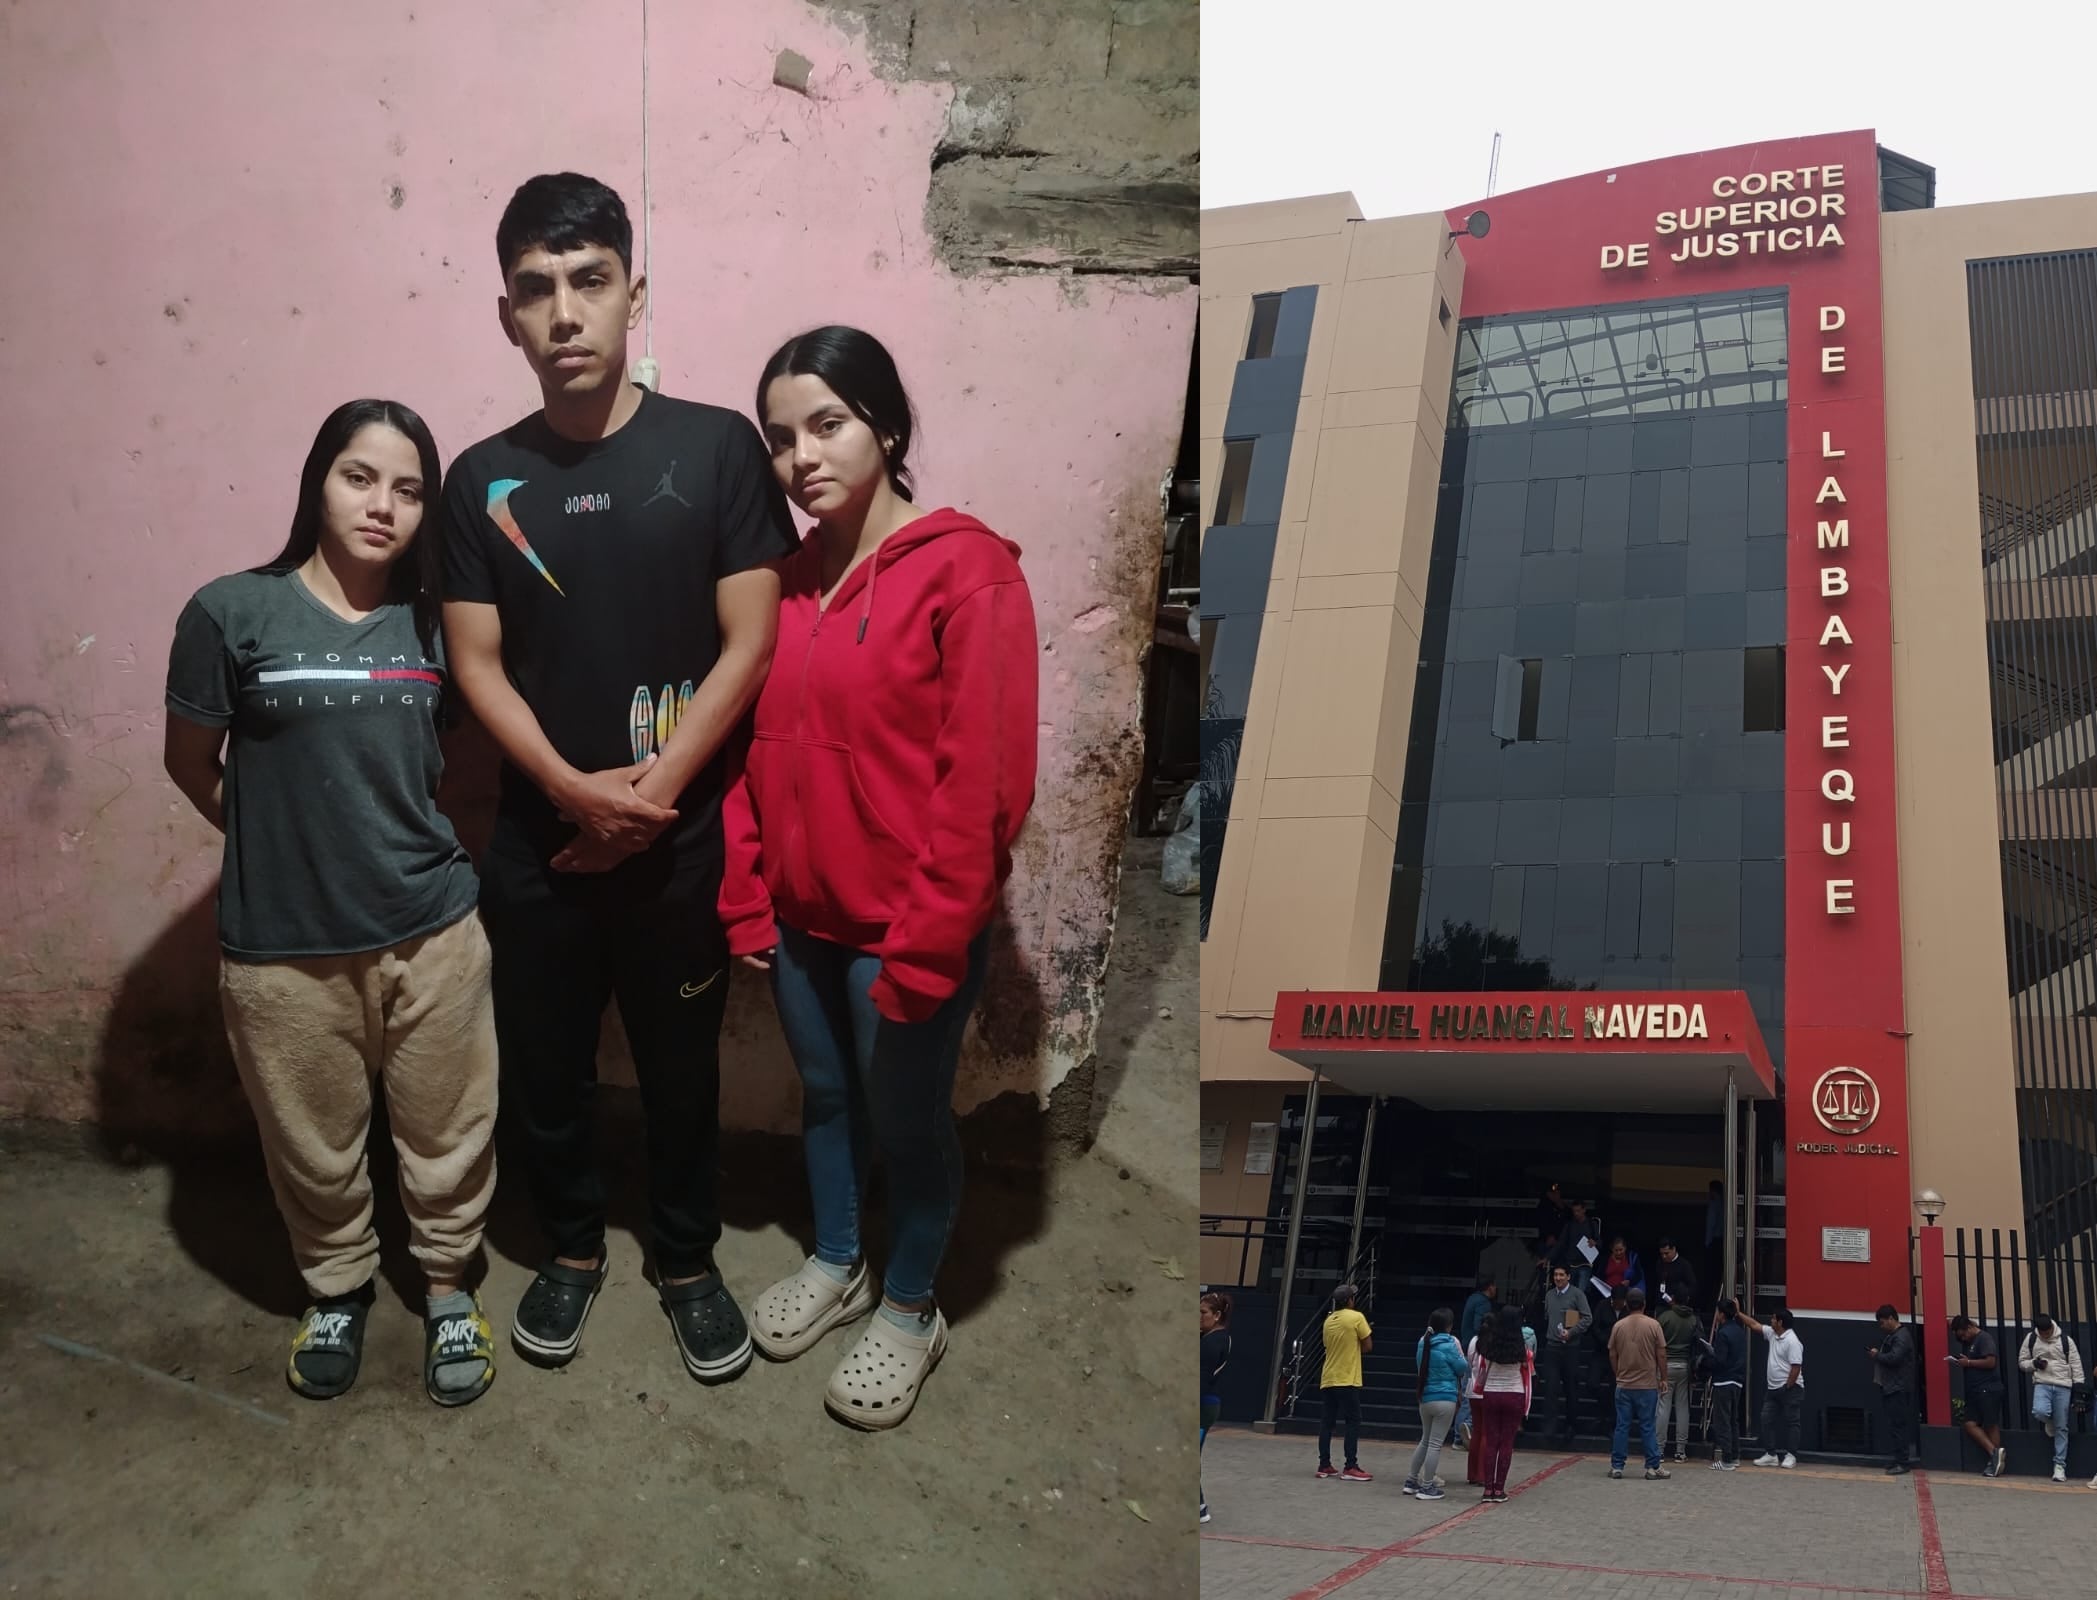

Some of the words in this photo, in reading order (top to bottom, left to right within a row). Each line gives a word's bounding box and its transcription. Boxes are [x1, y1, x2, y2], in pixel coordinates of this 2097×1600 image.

[1712, 164, 1845, 198] CORTE
[1655, 193, 1847, 235] SUPERIOR
[1600, 243, 1649, 269] DE
[1670, 223, 1846, 263] JUSTICIA
[1819, 305, 1847, 374] DE
[565, 492, 611, 514] JORDAN
[293, 653, 427, 665] TOMMY
[1815, 431, 1857, 915] LAMBAYEQUE
[265, 694, 433, 707] HILFIGE
[1302, 1003, 1420, 1038] MANUEL
[1430, 1004, 1575, 1039] HUANGAL
[1584, 1003, 1709, 1039] NAVEDA
[1796, 1143, 1838, 1153] PODER
[1844, 1143, 1899, 1155] JUDICIAL
[307, 1312, 353, 1338] SURF
[437, 1319, 480, 1345] SURF
